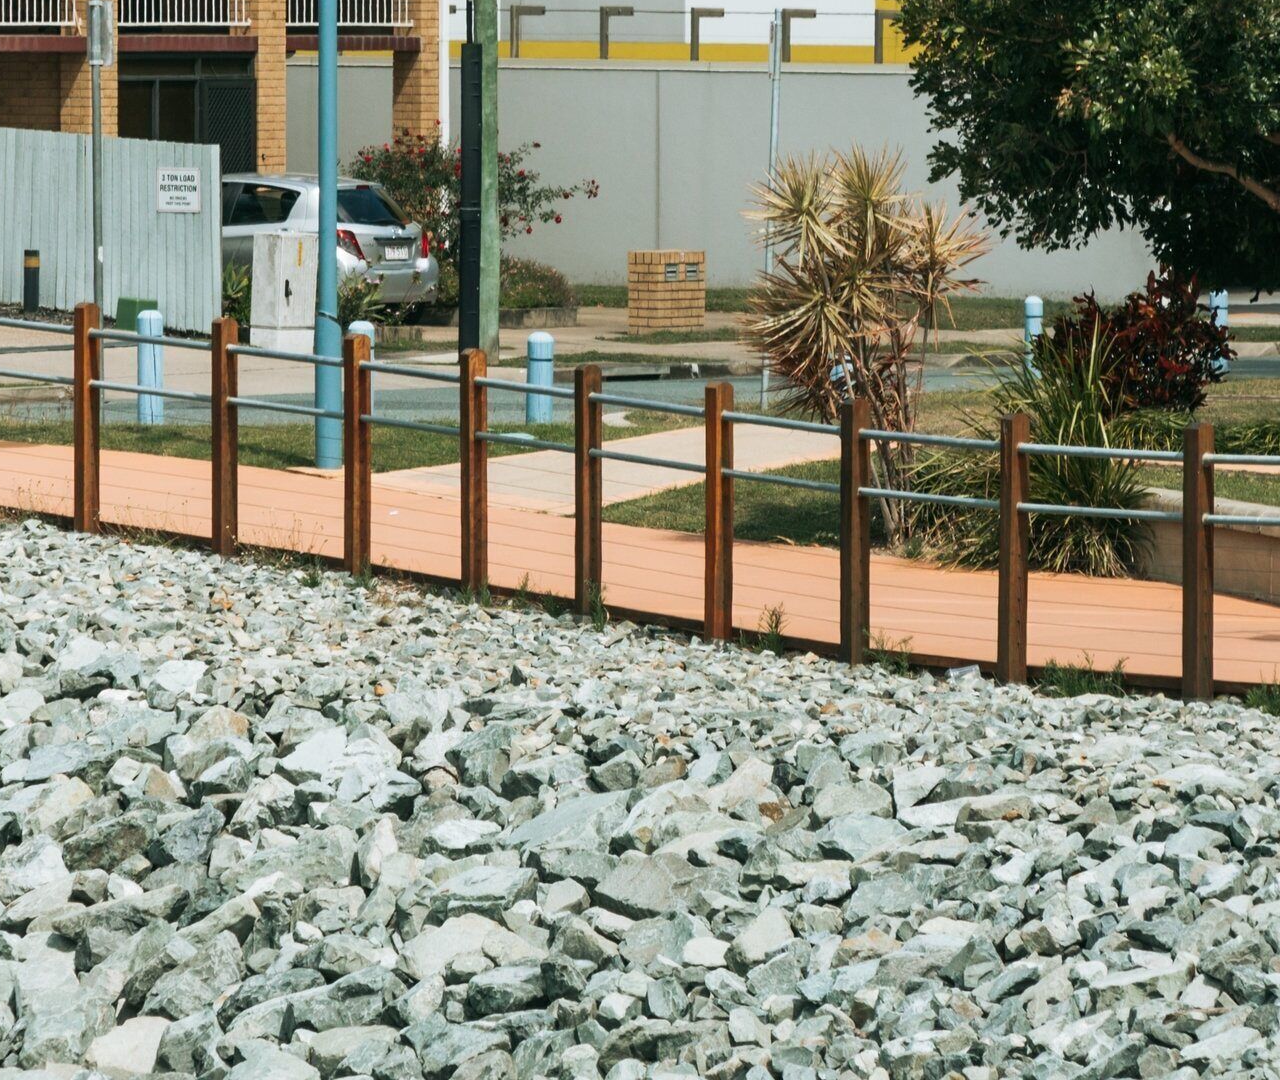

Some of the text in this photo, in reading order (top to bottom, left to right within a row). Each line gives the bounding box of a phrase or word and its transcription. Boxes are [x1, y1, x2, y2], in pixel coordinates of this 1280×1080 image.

[167, 174, 178, 182] TON
[180, 174, 195, 182] LOAD
[160, 184, 197, 192] RESTRICTION
